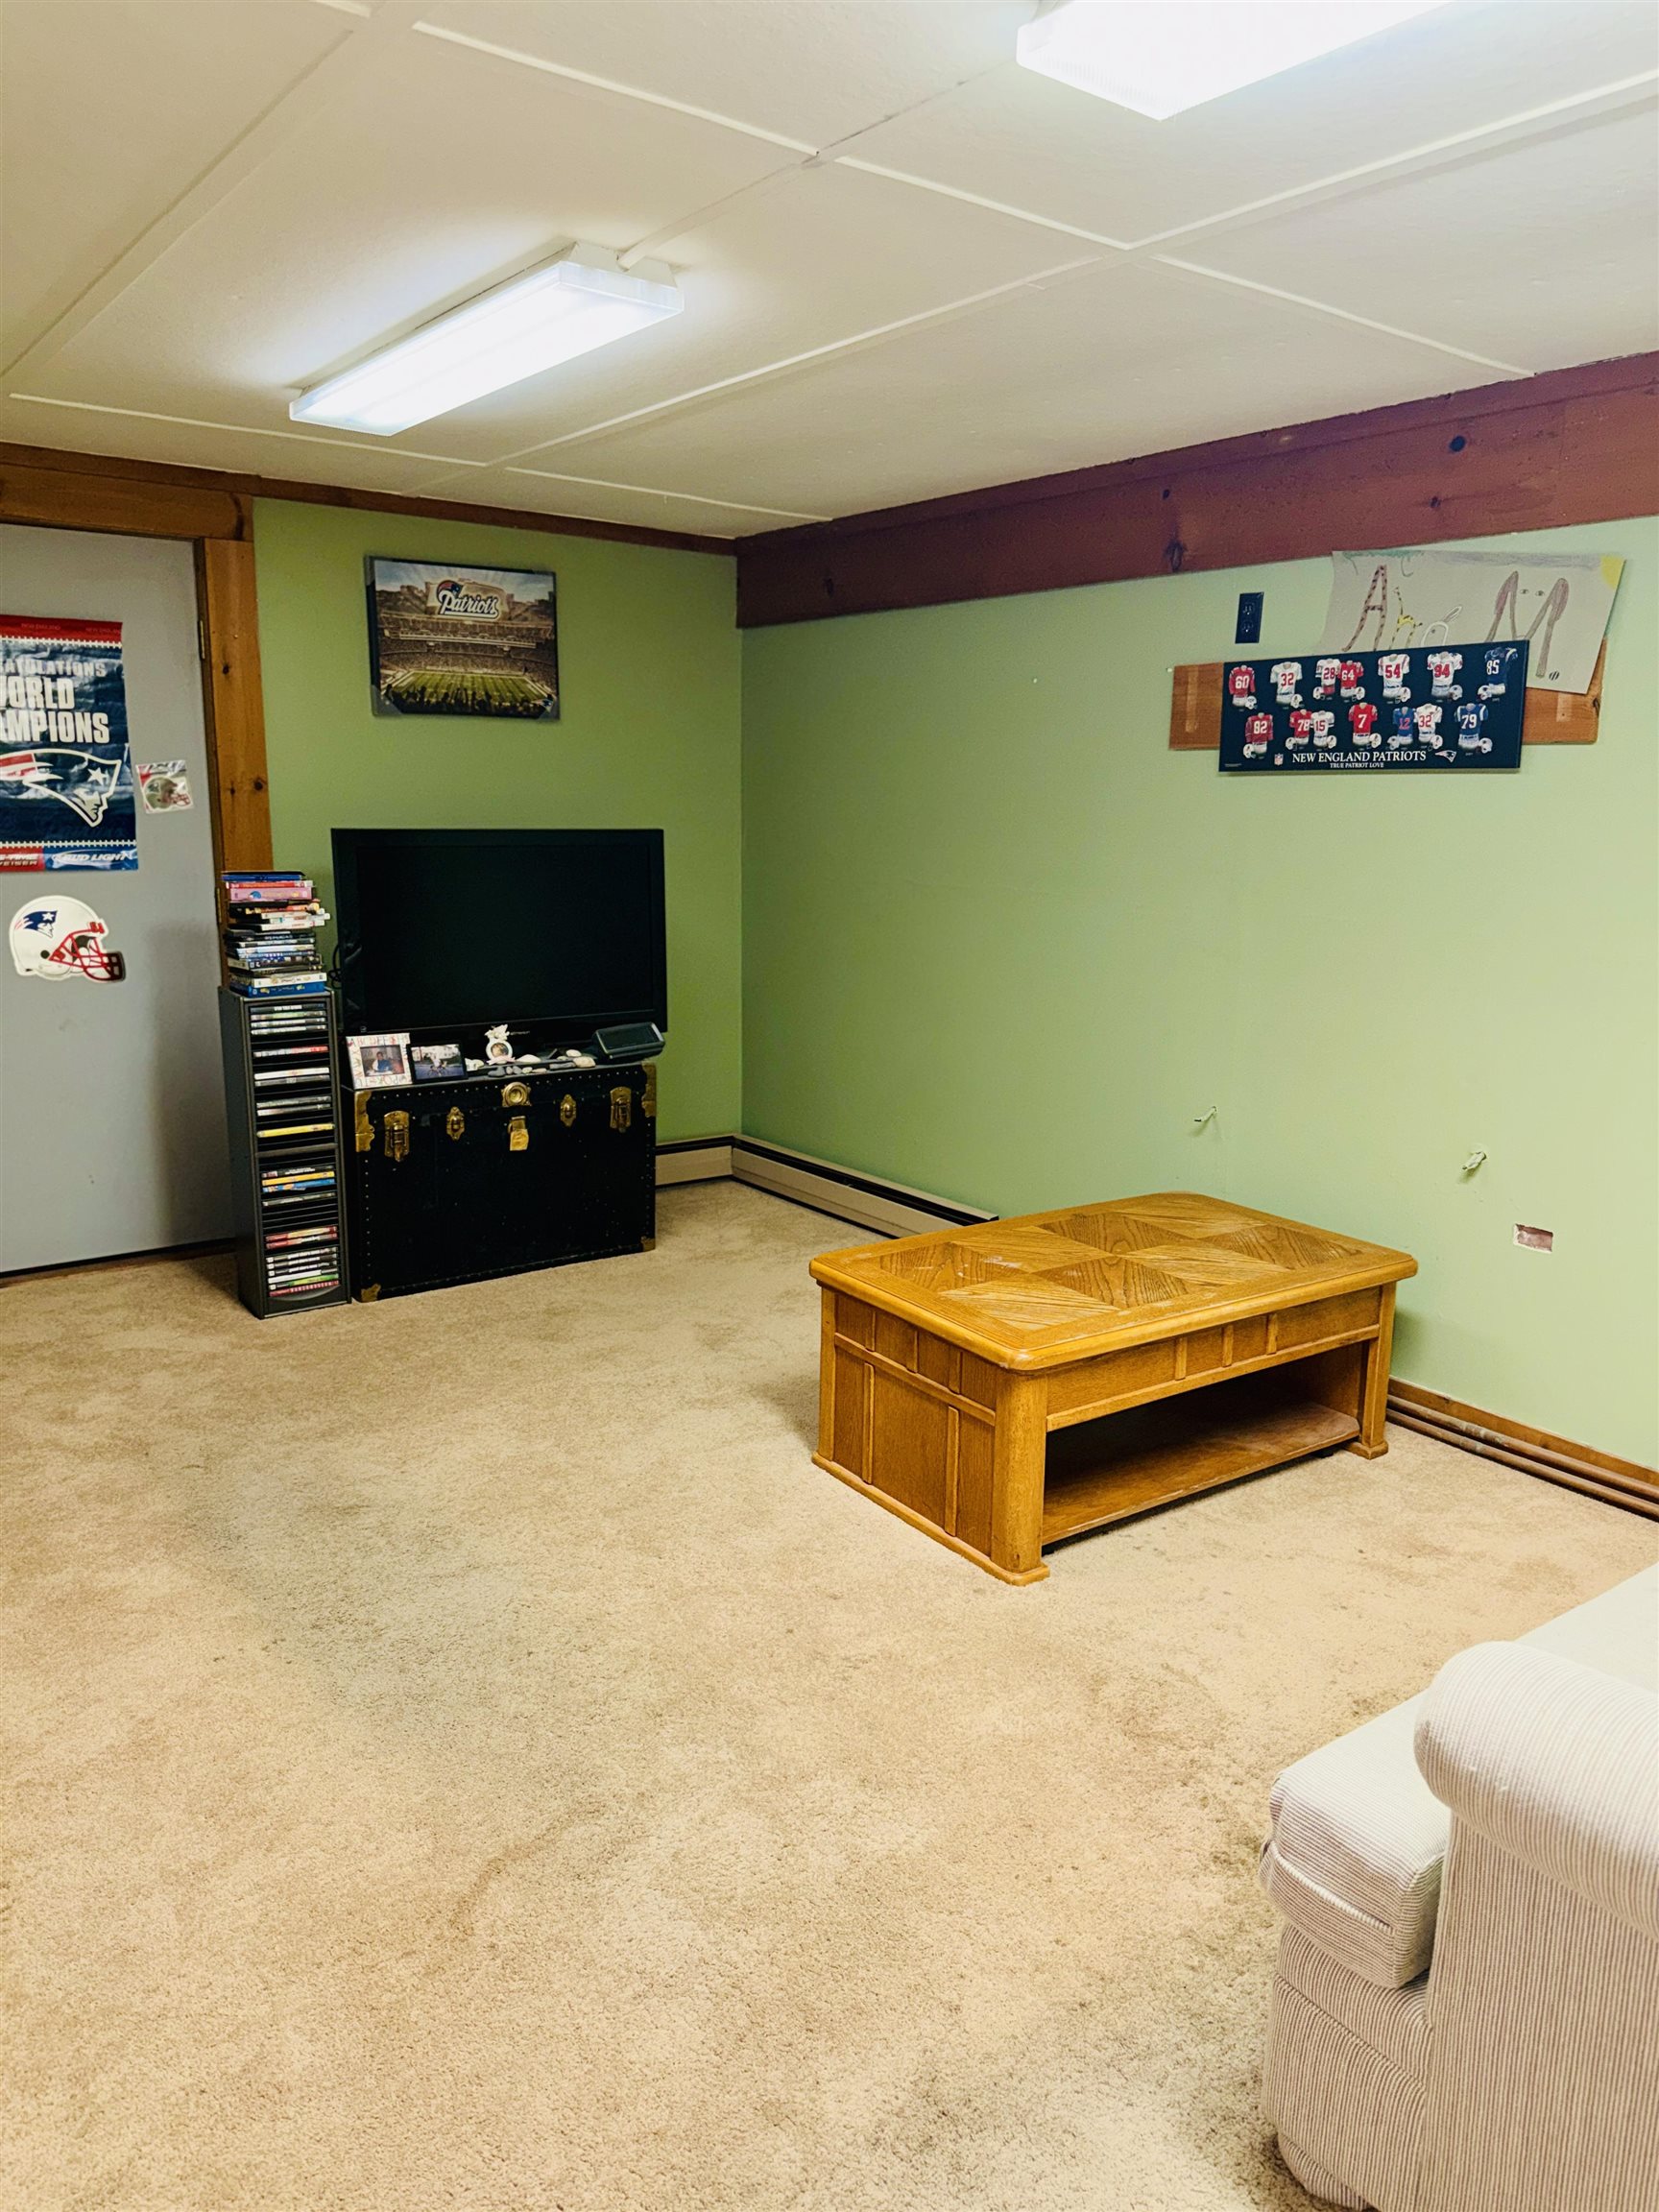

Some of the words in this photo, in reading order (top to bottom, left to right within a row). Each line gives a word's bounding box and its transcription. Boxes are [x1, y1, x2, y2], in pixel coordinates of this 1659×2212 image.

[438, 589, 498, 618] Patriots
[0, 658, 107, 678] ATULATIONS
[1324, 667, 1335, 680] 28
[1385, 663, 1401, 679] 54
[1434, 663, 1450, 678] 94
[1486, 660, 1500, 675] 85
[1235, 675, 1249, 689] 60
[1281, 672, 1294, 686] 32
[1341, 669, 1355, 682] 64
[1253, 720, 1267, 734] 82
[1298, 720, 1310, 732] 78
[1315, 720, 1326, 732] 15
[1358, 713, 1367, 729] 7
[1399, 718, 1410, 730] 12
[1419, 714, 1431, 728] 32
[1461, 713, 1477, 730] 79
[1292, 753, 1316, 763] NEW
[1318, 752, 1370, 762] ENGLAND
[1372, 751, 1427, 761] PATRIOTS
[91, 853, 126, 861] LIGHT
